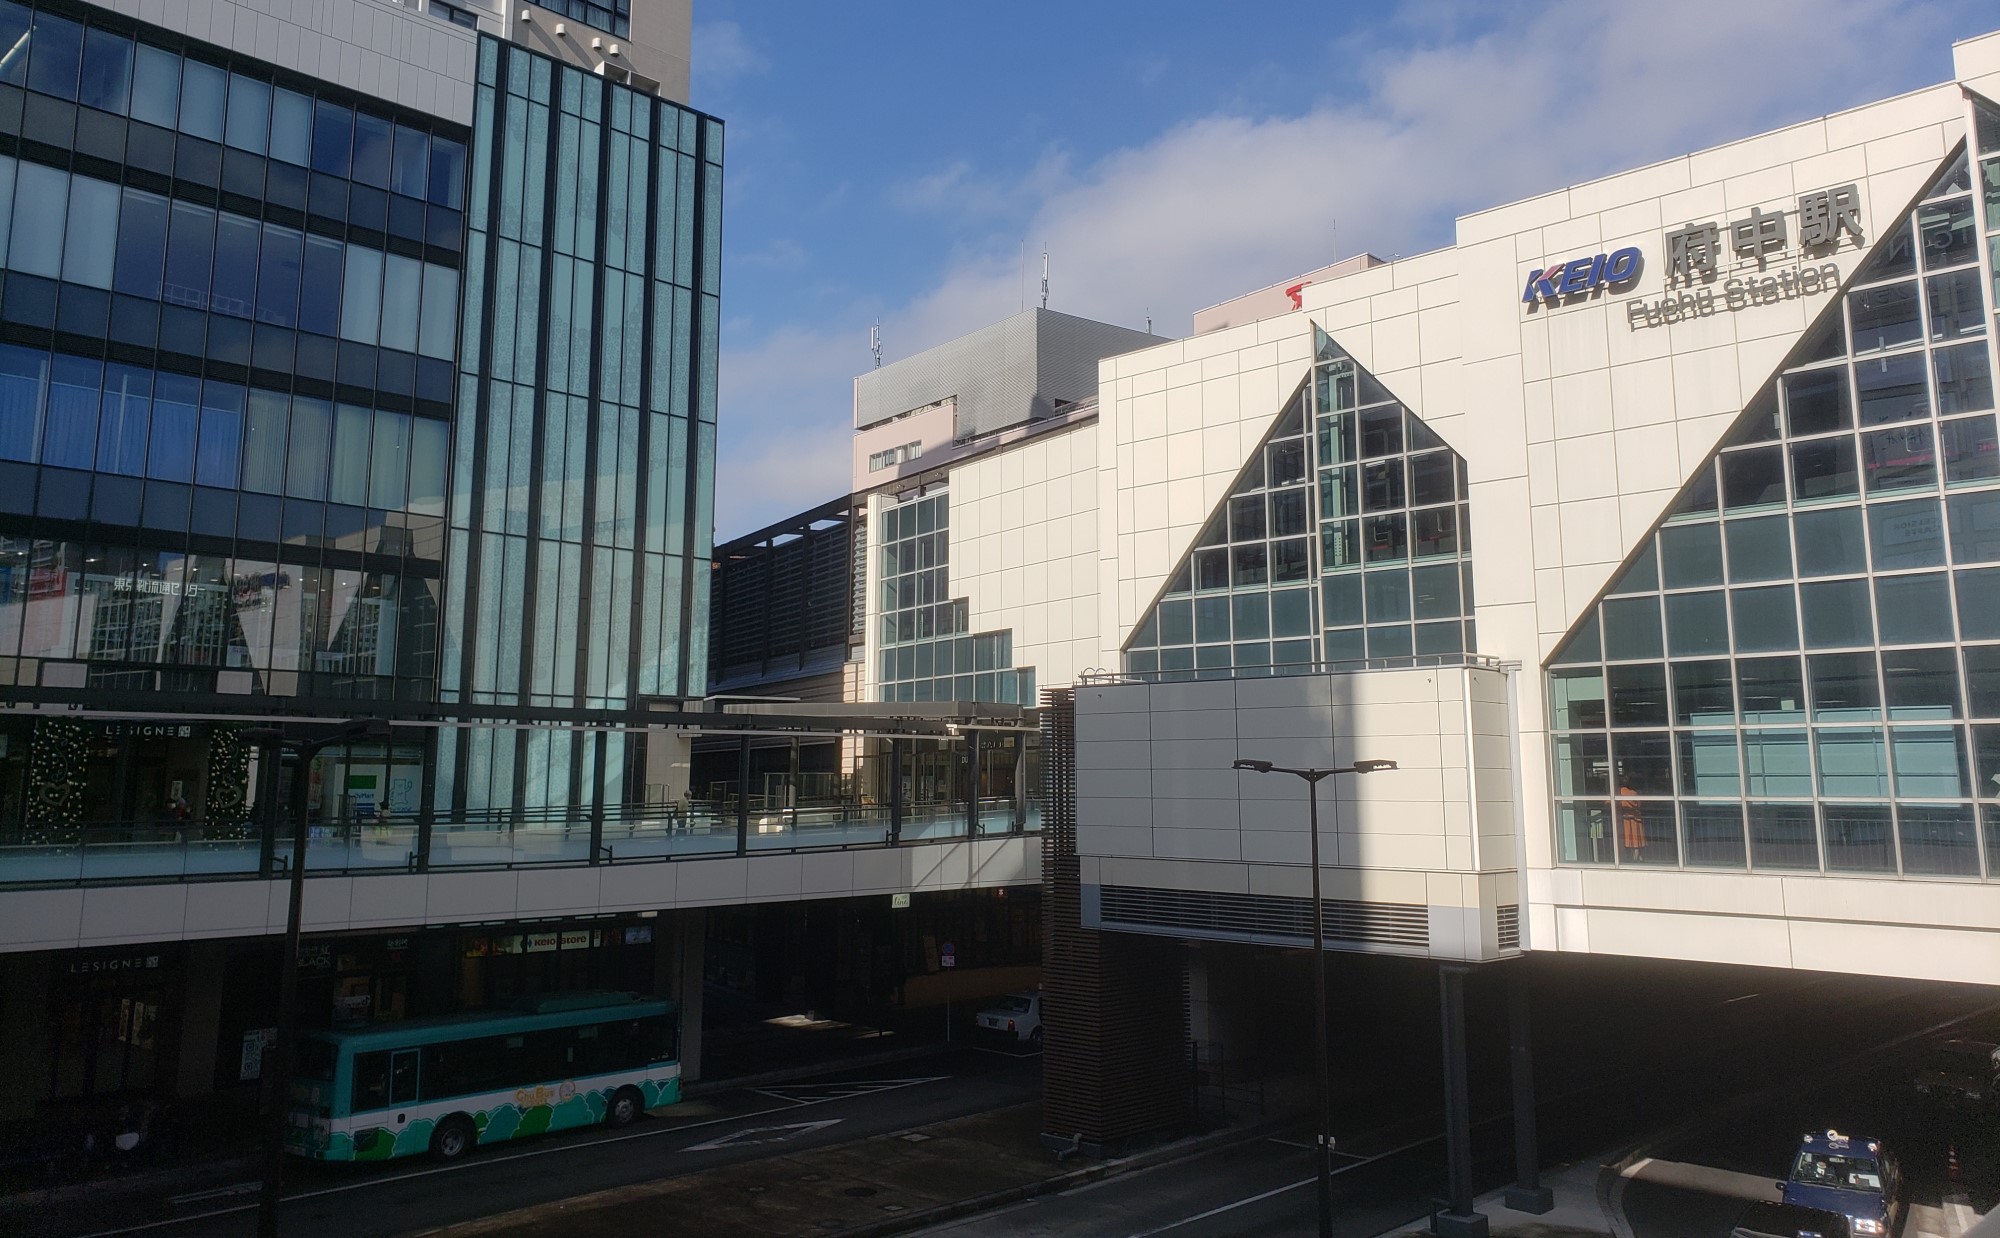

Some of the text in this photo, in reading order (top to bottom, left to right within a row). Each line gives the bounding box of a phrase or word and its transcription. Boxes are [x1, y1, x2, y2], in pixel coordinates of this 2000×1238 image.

[1664, 183, 1864, 279] 府中駅
[1522, 247, 1643, 304] KEIO
[1724, 262, 1840, 302] Station
